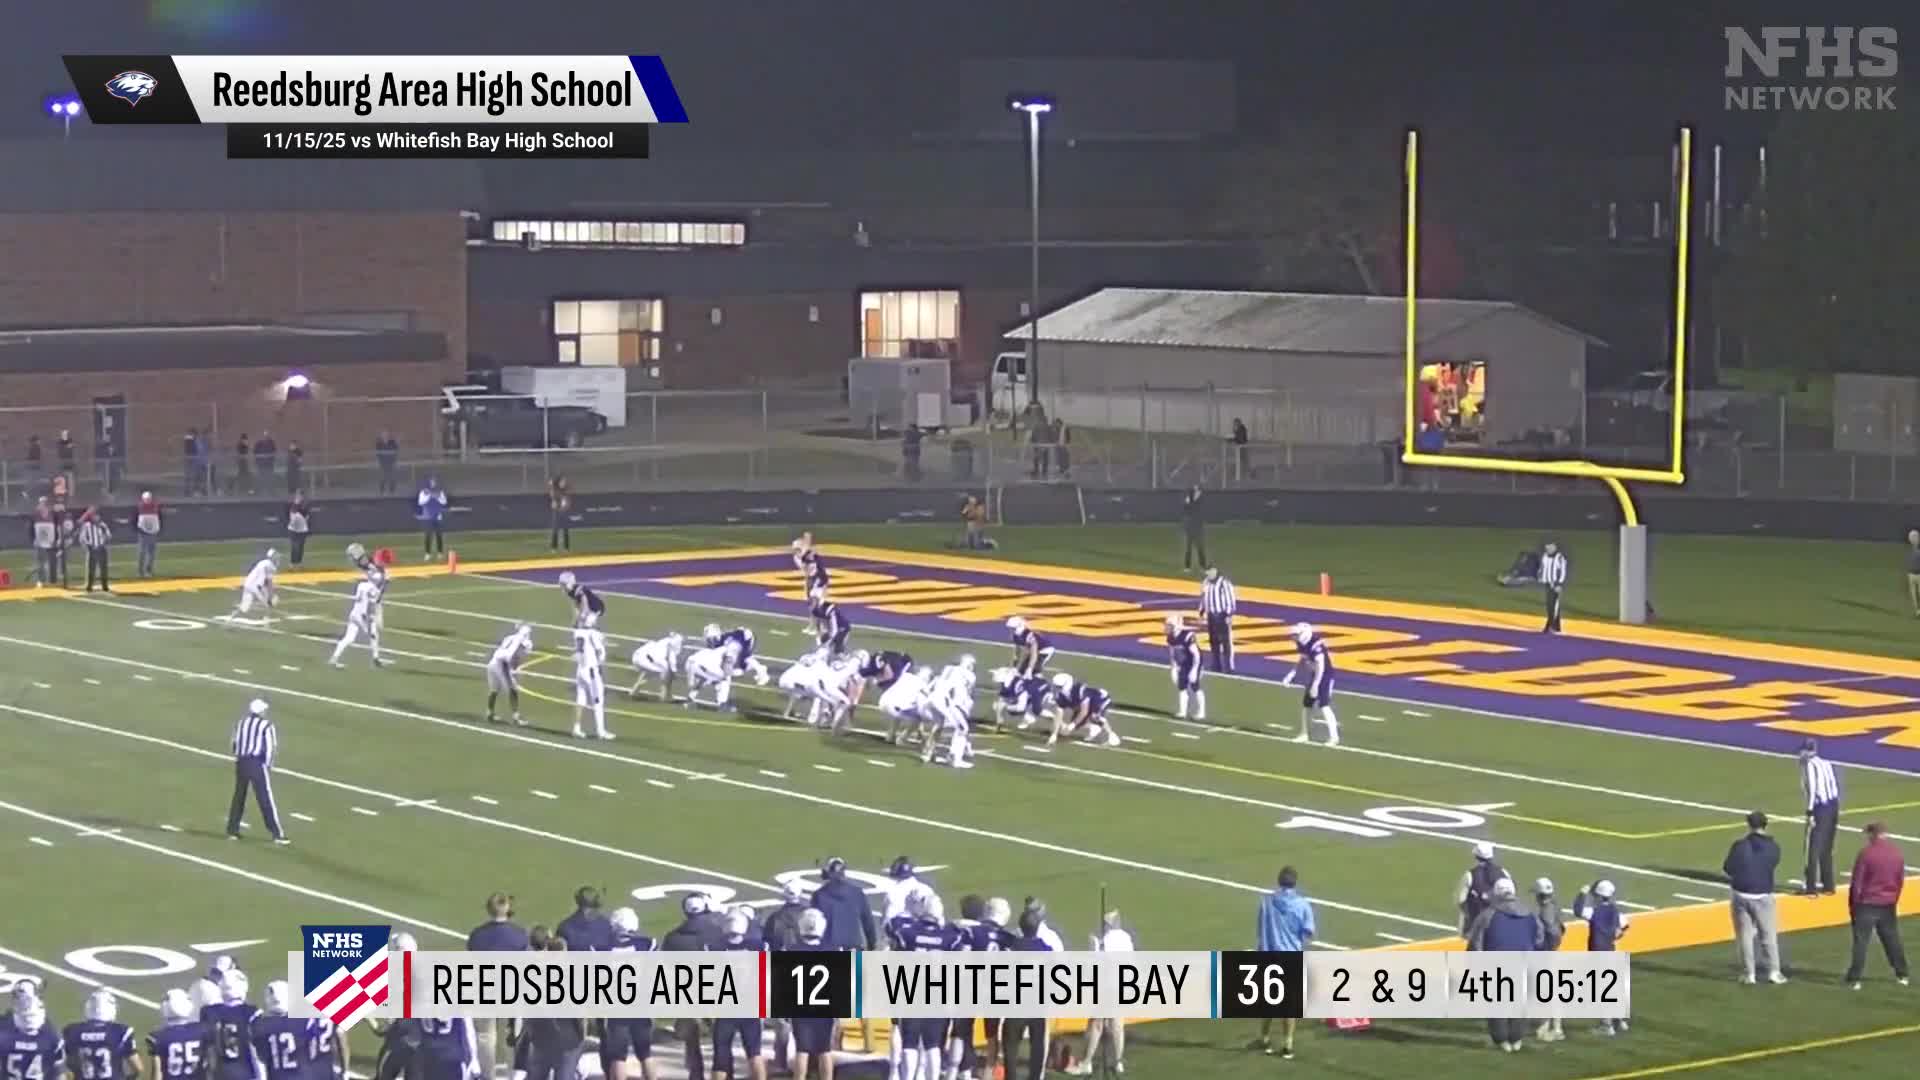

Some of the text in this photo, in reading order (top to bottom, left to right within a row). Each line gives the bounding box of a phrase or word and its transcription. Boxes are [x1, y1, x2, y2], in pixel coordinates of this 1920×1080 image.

[7, 1053, 44, 1080] 54
[168, 1041, 200, 1075] 65
[268, 1032, 298, 1069] 12
